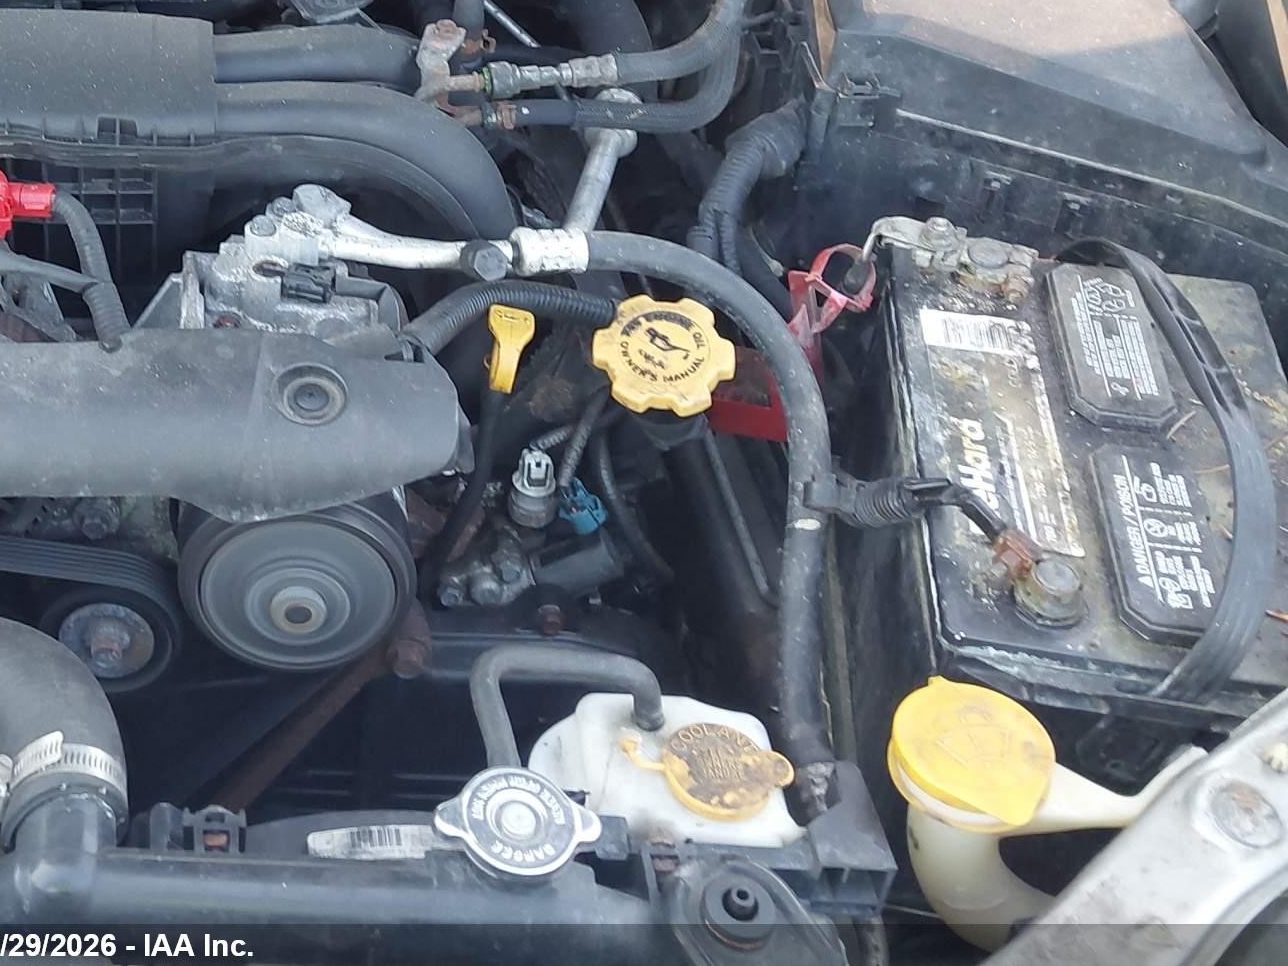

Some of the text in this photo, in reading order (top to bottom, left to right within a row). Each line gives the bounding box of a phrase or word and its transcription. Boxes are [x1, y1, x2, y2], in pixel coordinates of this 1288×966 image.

[620, 340, 658, 382] OWNER'S
[662, 355, 705, 383] MANUAL
[693, 332, 707, 349] OIL
[1113, 474, 1137, 517] POISON
[1127, 525, 1151, 575] DANGER
[490, 840, 557, 863] DANGER
